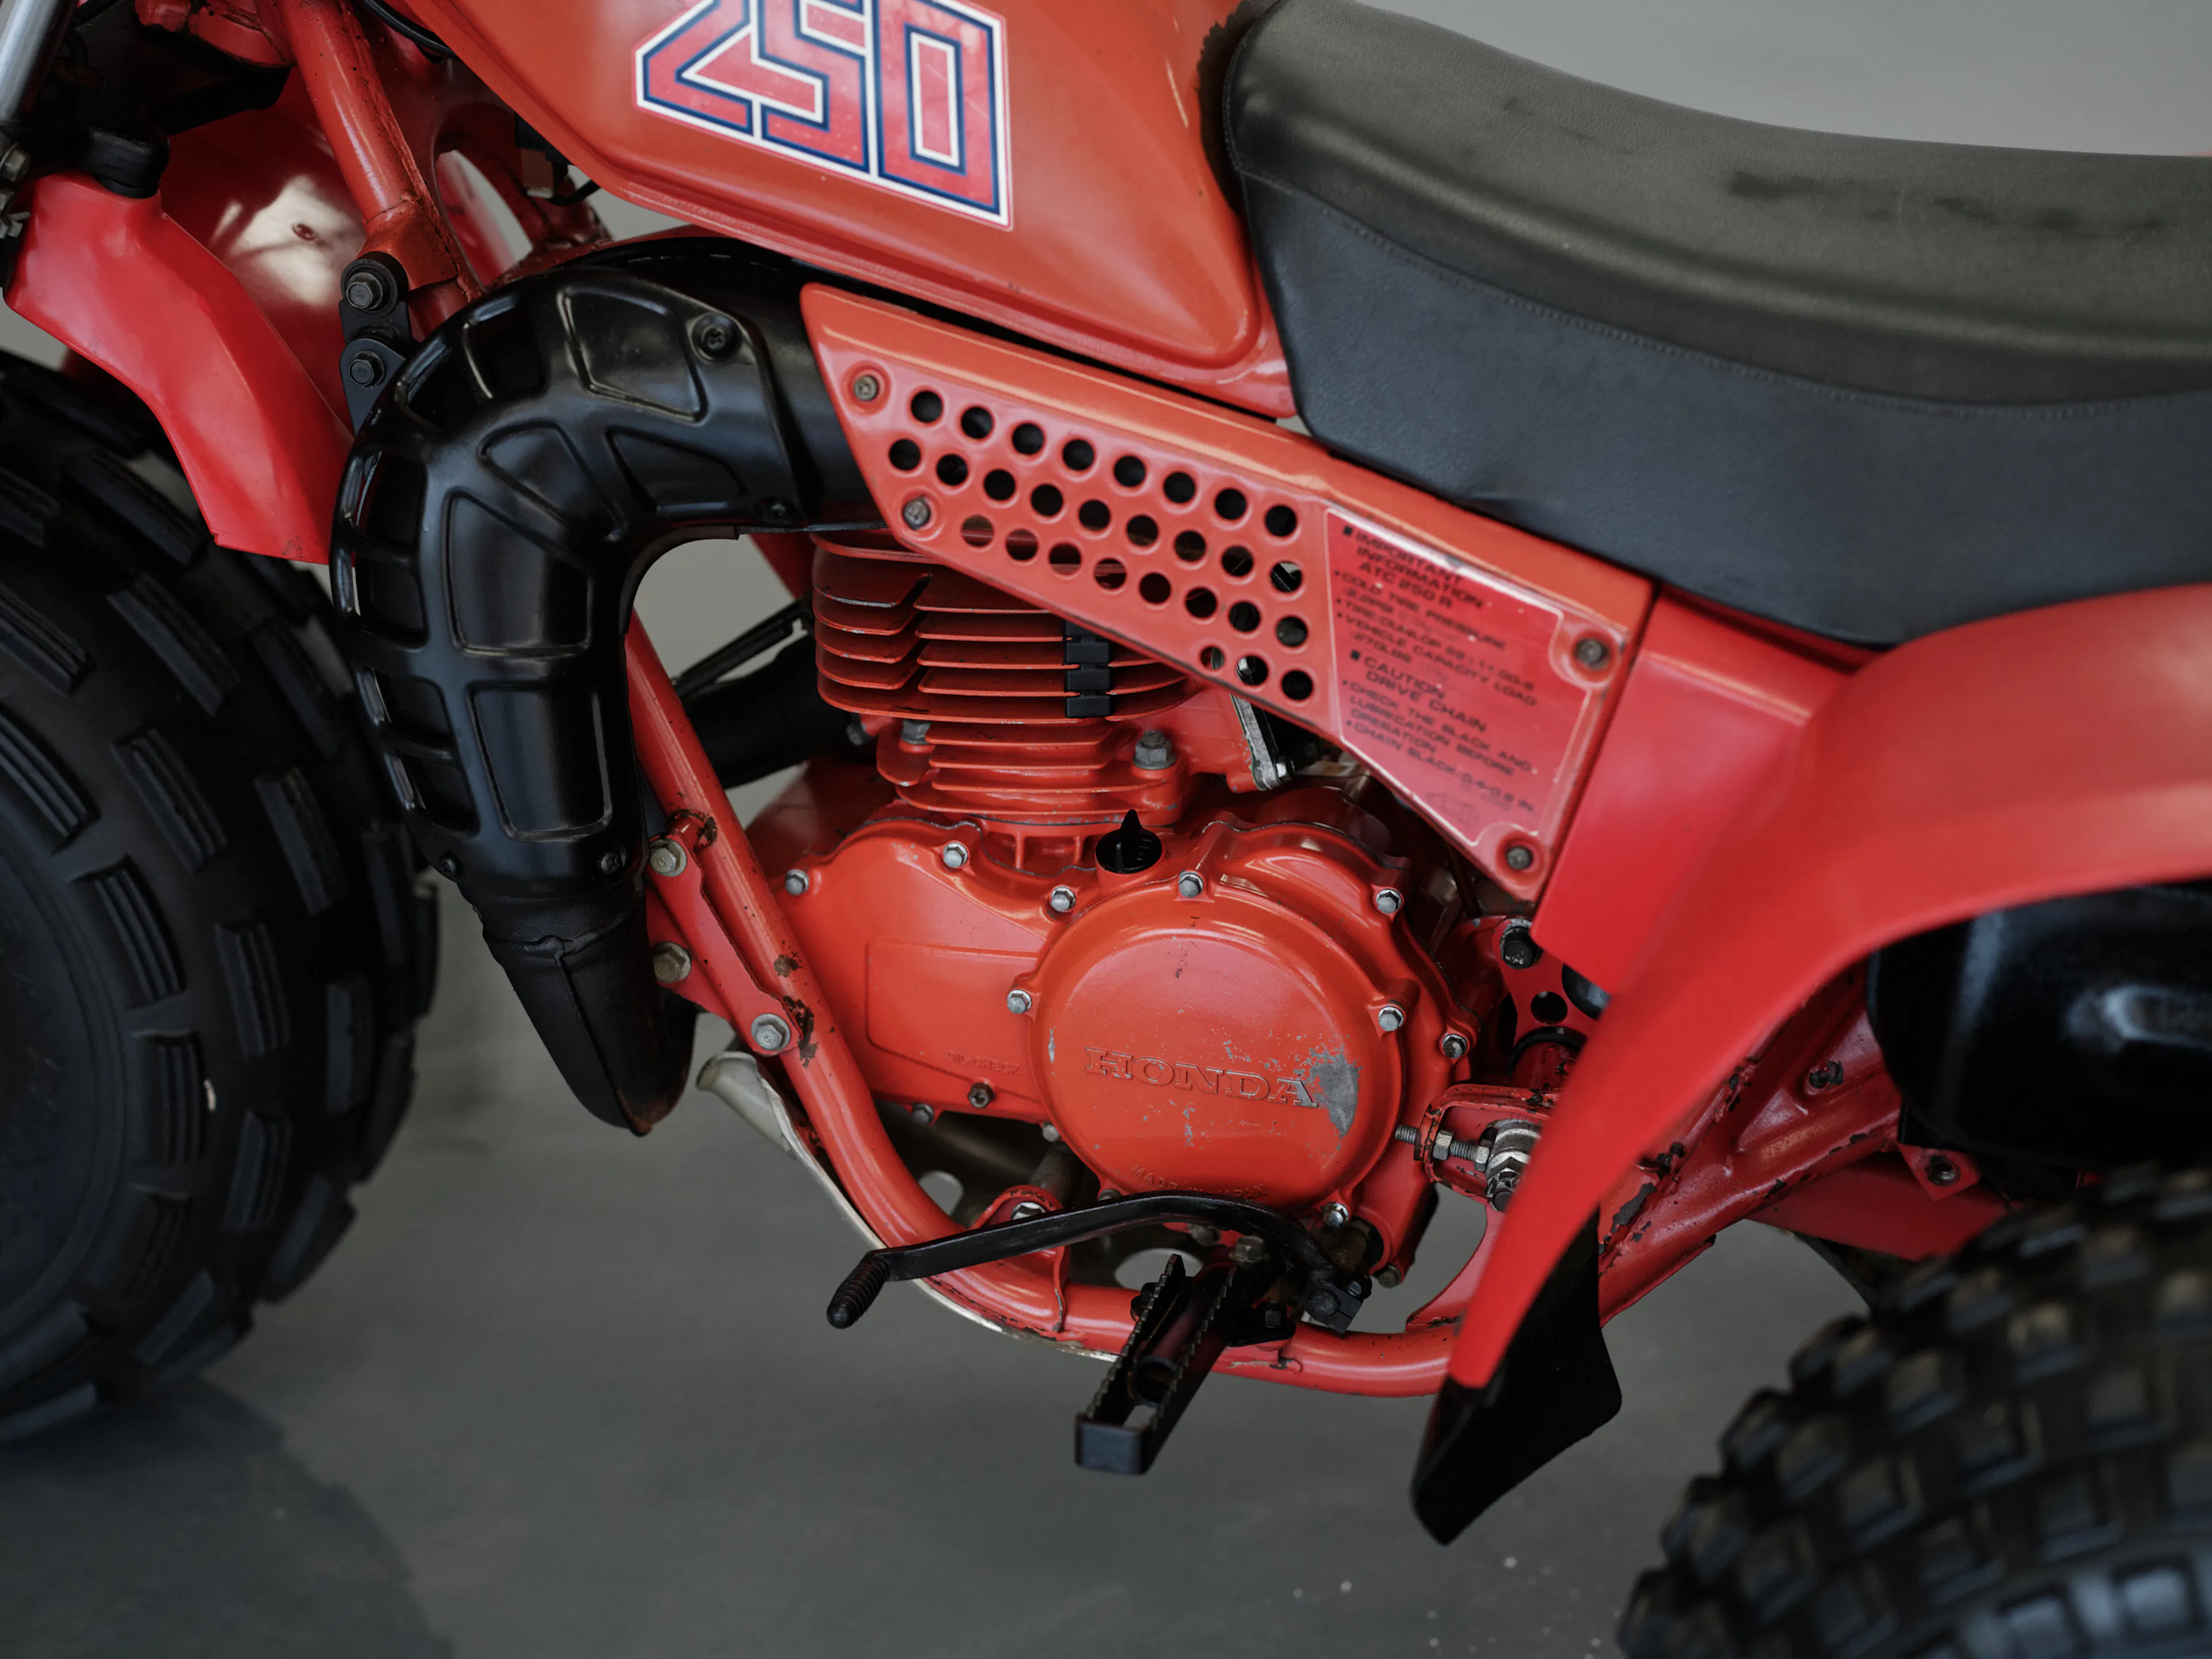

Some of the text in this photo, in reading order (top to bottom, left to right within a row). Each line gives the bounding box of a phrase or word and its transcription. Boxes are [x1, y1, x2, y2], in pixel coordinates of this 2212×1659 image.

[634, 0, 1013, 228] 250
[1358, 560, 1397, 585] ATC
[1363, 656, 1446, 700] CAUTION
[1365, 670, 1421, 703] DRIVE
[1427, 698, 1488, 733] CHAIN
[1084, 1046, 1319, 1109] HONDA
